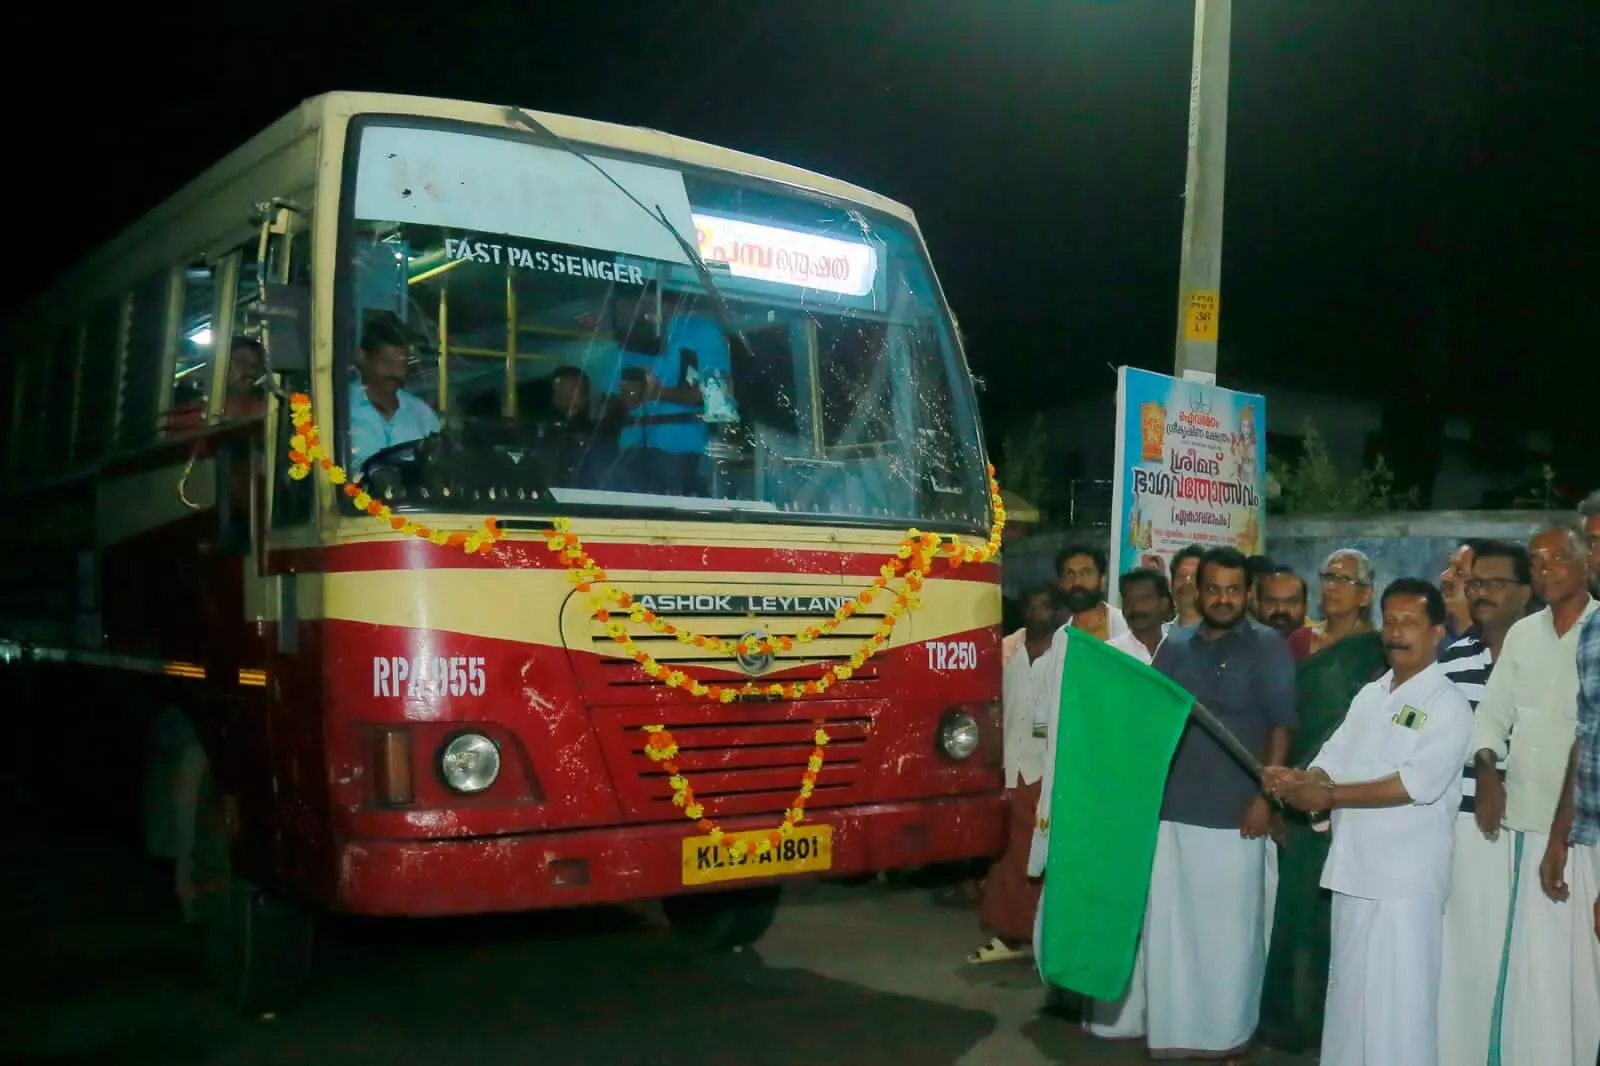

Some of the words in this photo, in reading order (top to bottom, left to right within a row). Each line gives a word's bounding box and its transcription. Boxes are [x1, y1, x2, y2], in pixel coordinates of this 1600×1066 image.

[444, 238, 503, 265] FAST
[508, 247, 645, 286] PASSENGER
[641, 595, 733, 611] ASHOK
[926, 642, 977, 670] TR250
